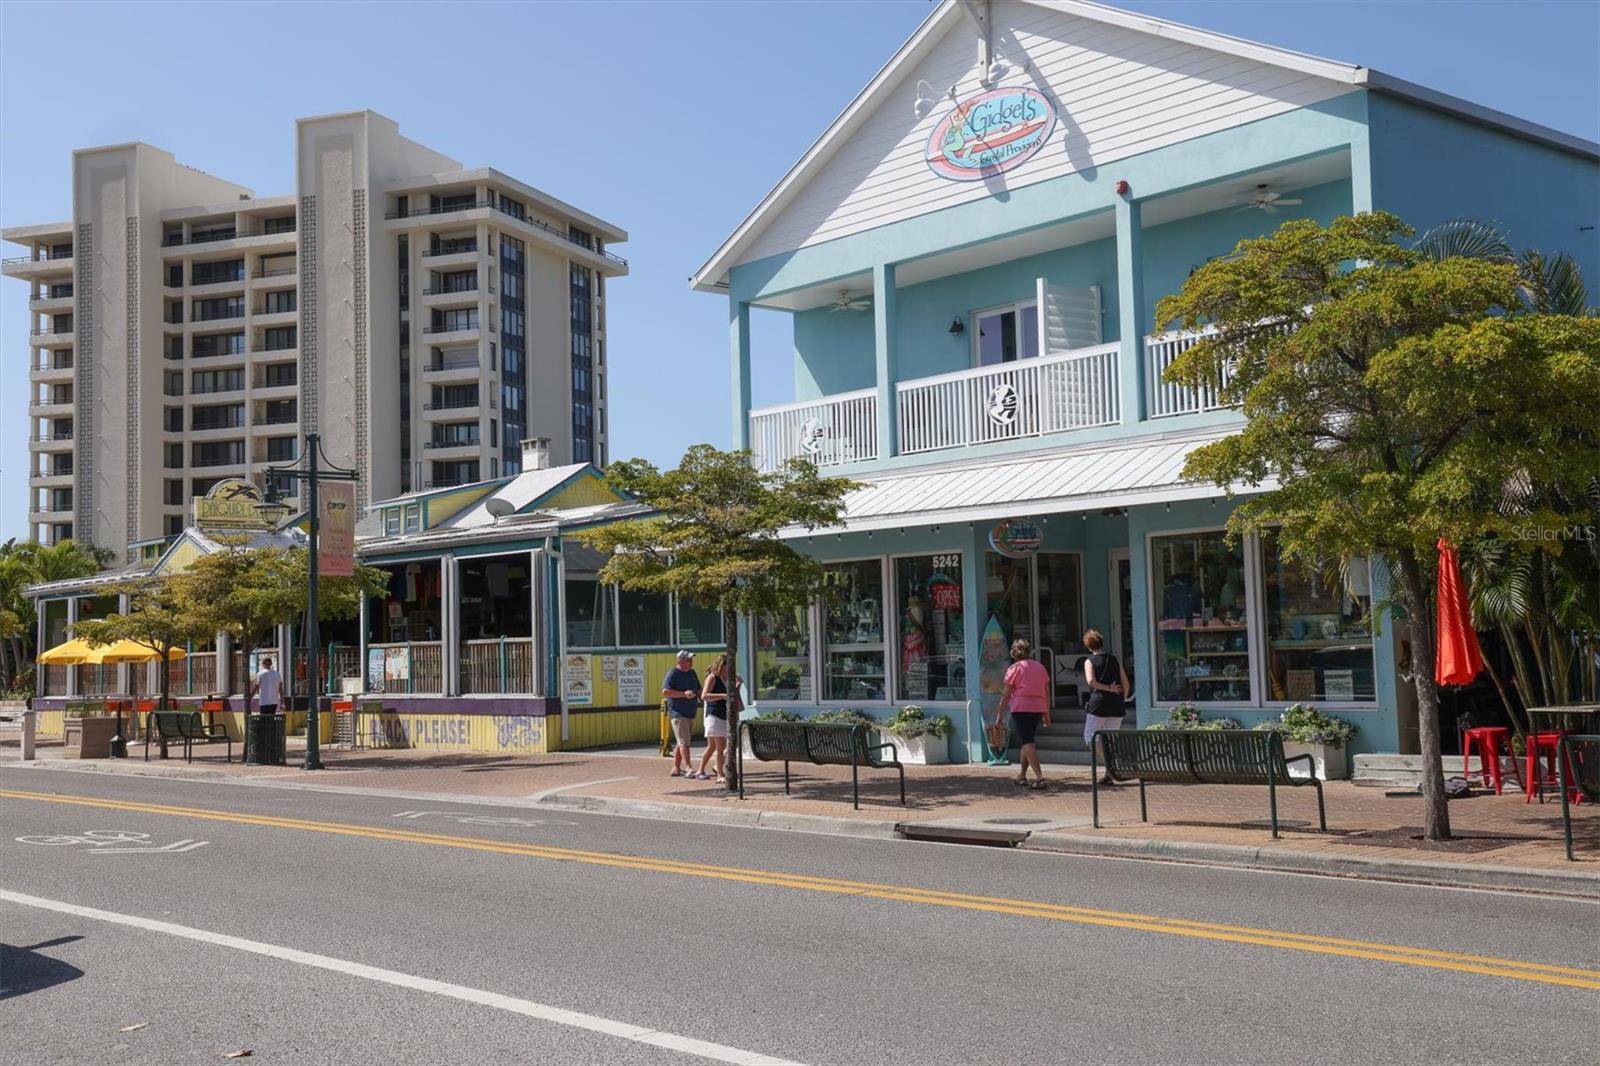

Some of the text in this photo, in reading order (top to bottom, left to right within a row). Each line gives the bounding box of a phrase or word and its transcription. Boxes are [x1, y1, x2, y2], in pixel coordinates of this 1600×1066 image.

[971, 92, 1037, 141] Gidgets
[932, 554, 959, 568] 5242
[936, 590, 960, 608] OPEN
[416, 719, 471, 745] PLEASE!
